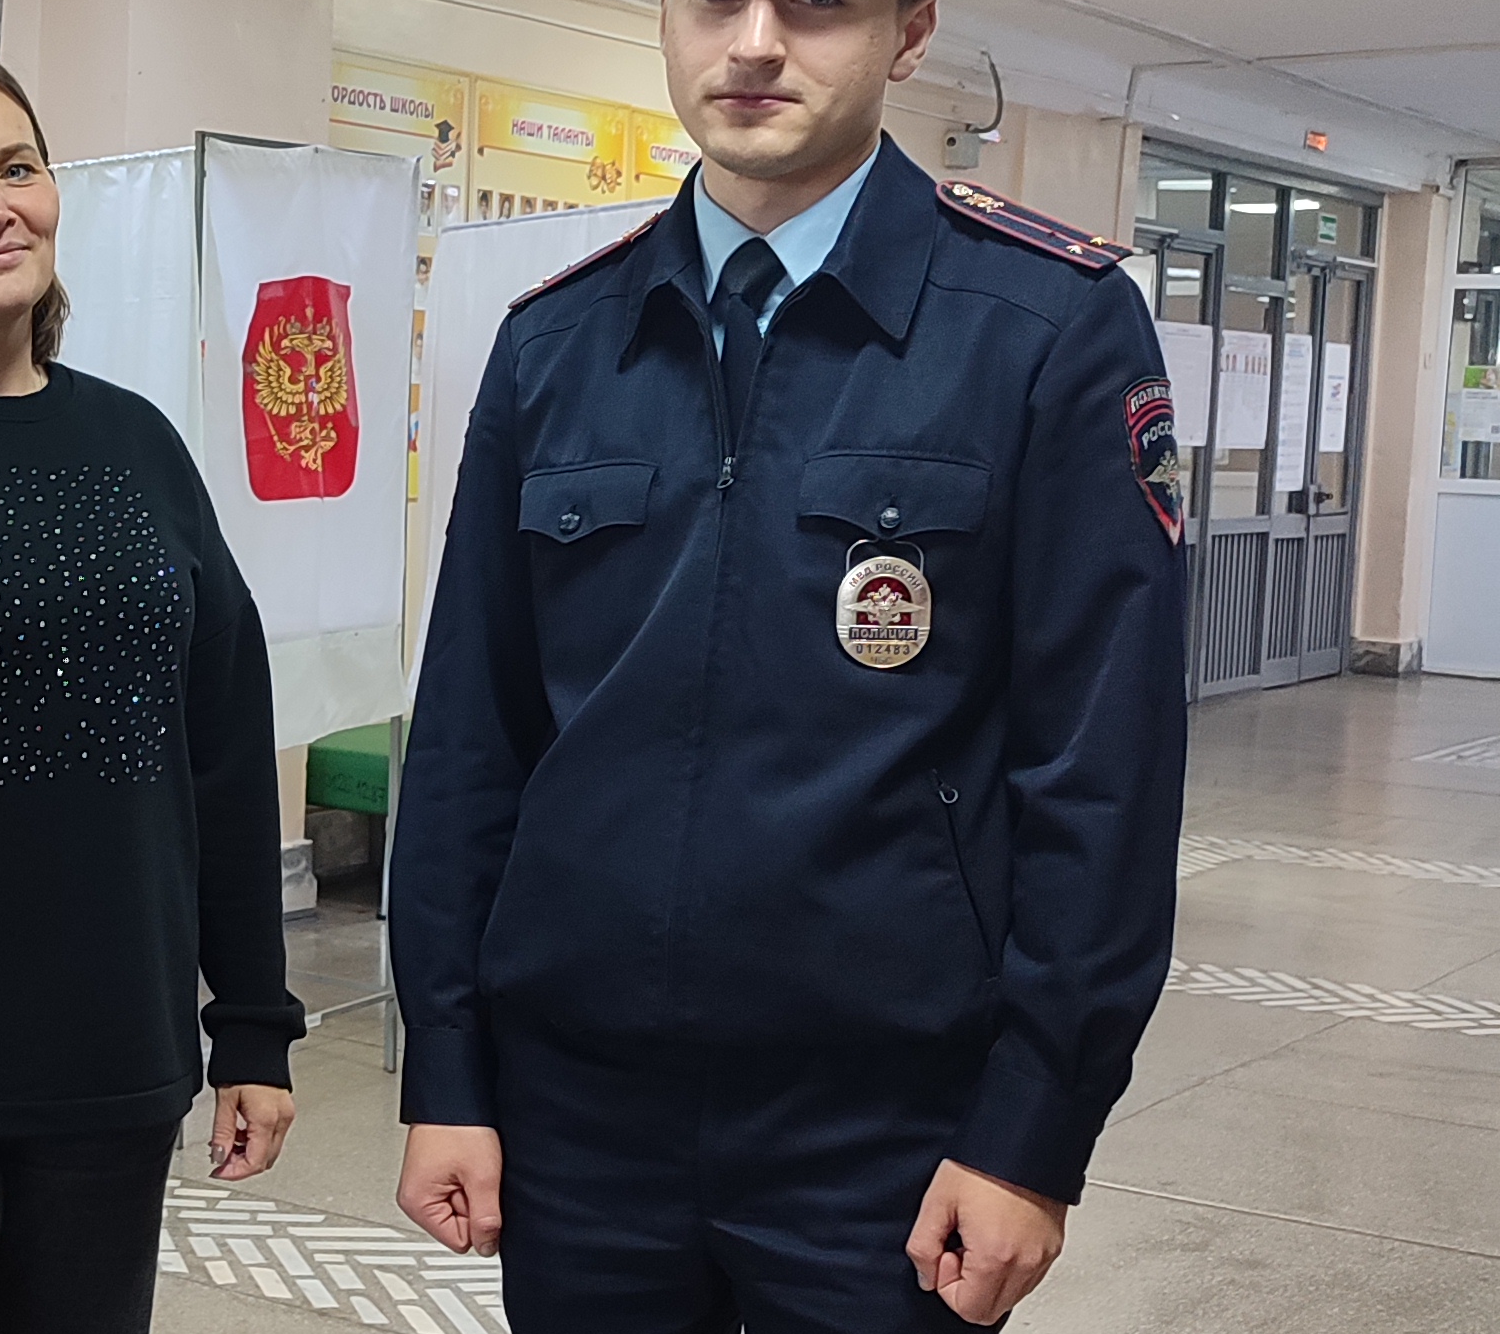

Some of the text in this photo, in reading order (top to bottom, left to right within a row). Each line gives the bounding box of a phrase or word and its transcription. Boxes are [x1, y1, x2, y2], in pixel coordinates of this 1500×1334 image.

[331, 85, 435, 119] ОРДОСТЬ ШКОЛЫ
[512, 118, 595, 147] НАШИ ТАЛАНТЫ
[1141, 420, 1174, 450] РОСС
[848, 563, 923, 591] МВД РОССИИ
[851, 628, 916, 639] ПОЛИЦИЯ
[856, 644, 911, 656] 012483
